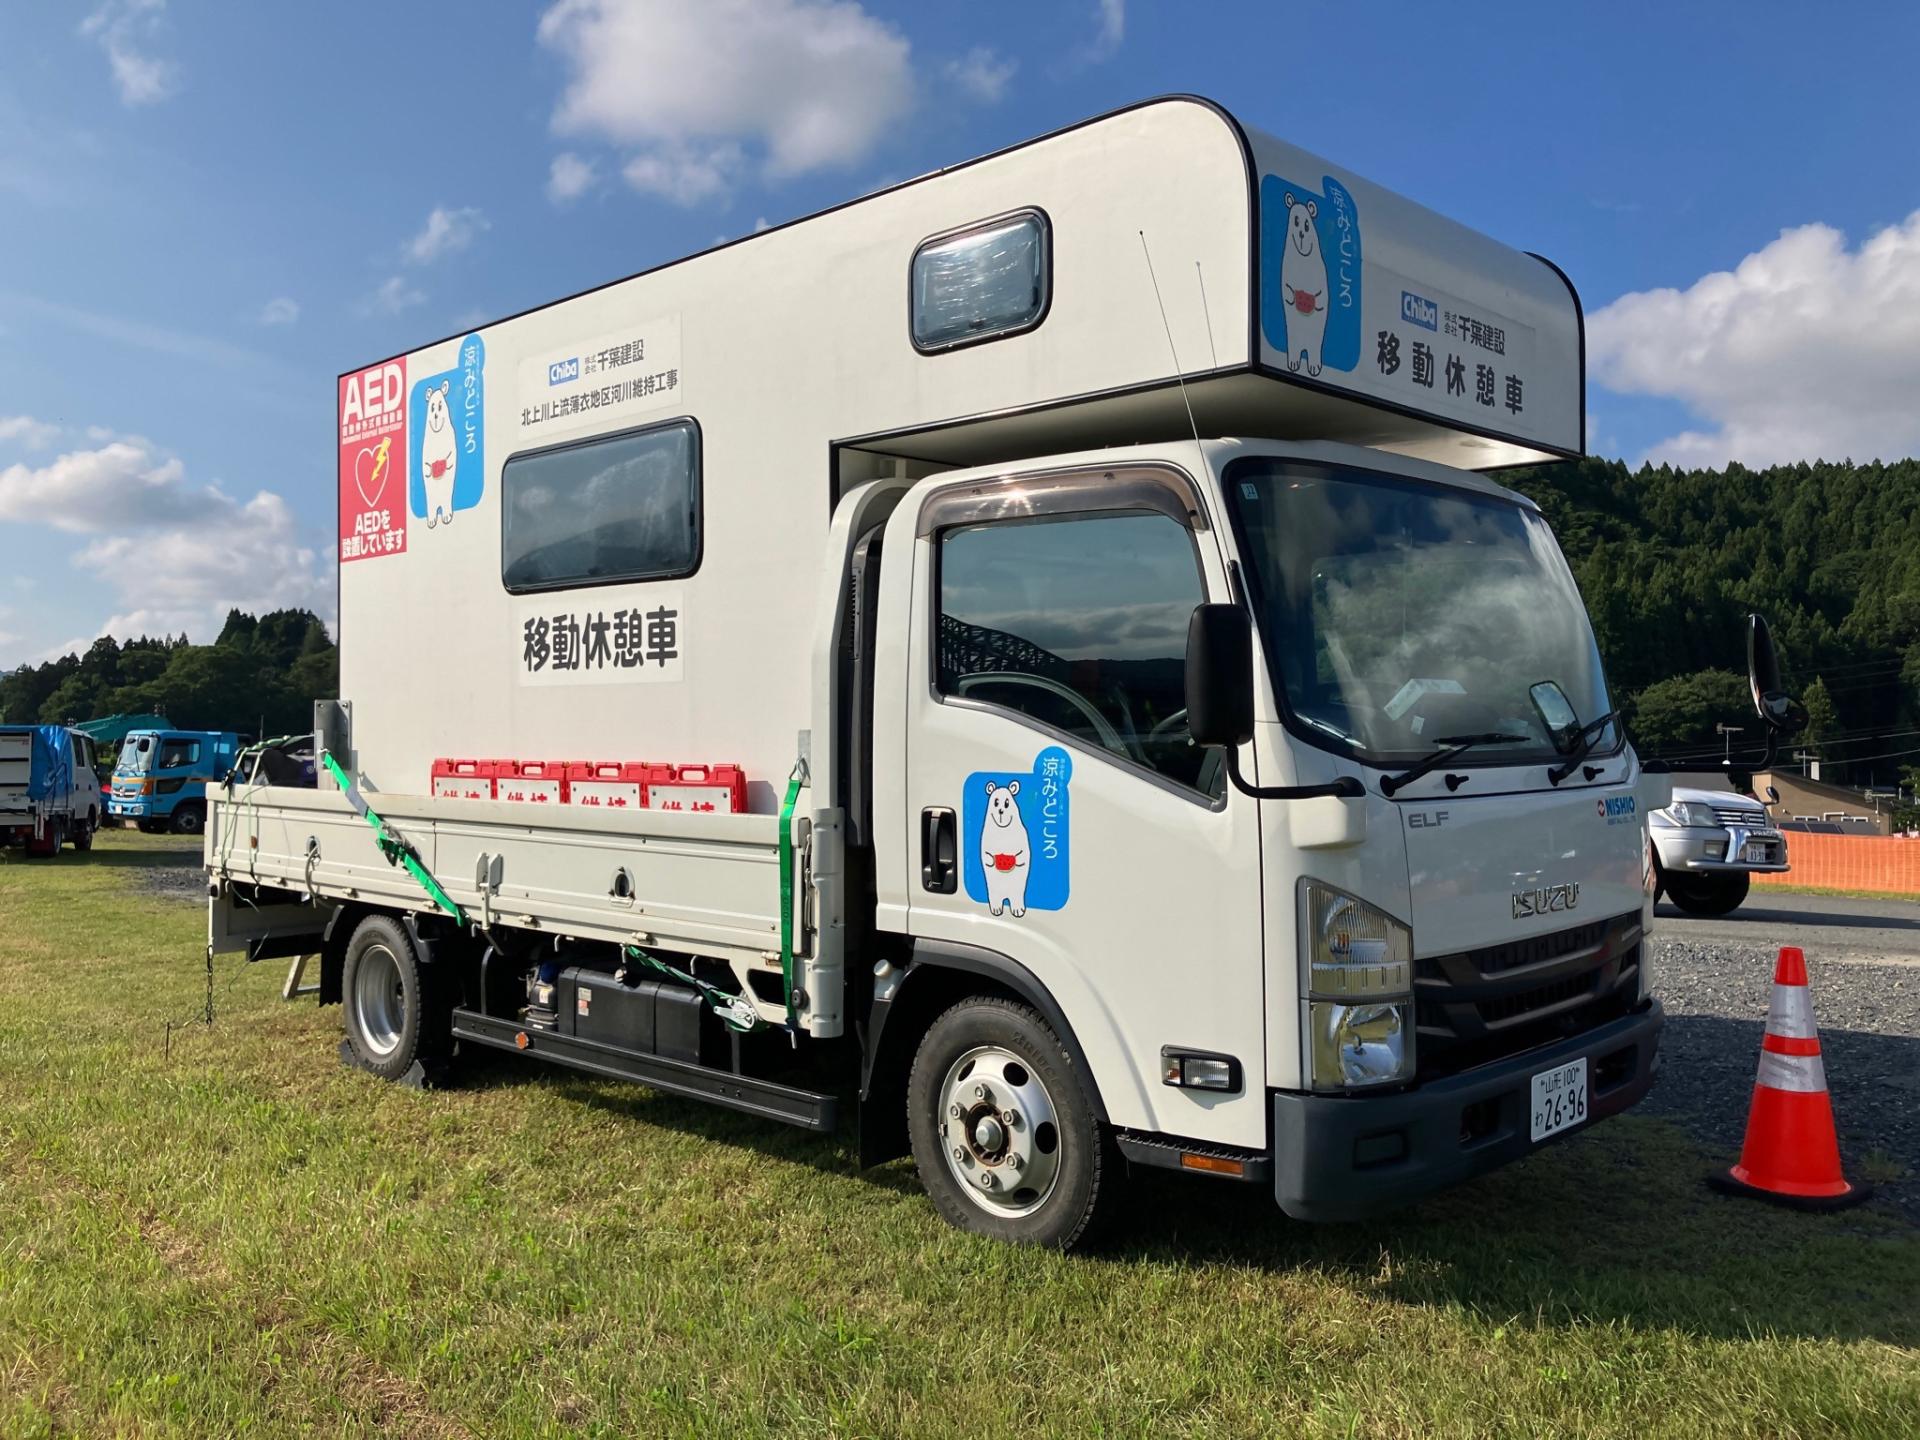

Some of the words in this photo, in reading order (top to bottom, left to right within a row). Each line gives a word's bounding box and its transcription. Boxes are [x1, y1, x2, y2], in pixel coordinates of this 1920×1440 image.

[1403, 295, 1436, 326] Chiba
[1458, 315, 1506, 357] 千葉建設
[550, 360, 577, 383] Chiba
[597, 338, 644, 372] 千葉建設
[1376, 330, 1524, 416] 移動休憩車
[342, 363, 403, 425] AED
[521, 368, 679, 427] 北上川上流薄衣地区河川維持工事
[354, 509, 391, 536] AEDを
[522, 604, 679, 672] 移動休憩車
[1408, 811, 1450, 829] ELF
[1605, 796, 1635, 817] NISHIO
[1512, 881, 1579, 920] ISUZU
[1563, 1067, 1576, 1087] 100
[1545, 1085, 1584, 1131] 26-96
